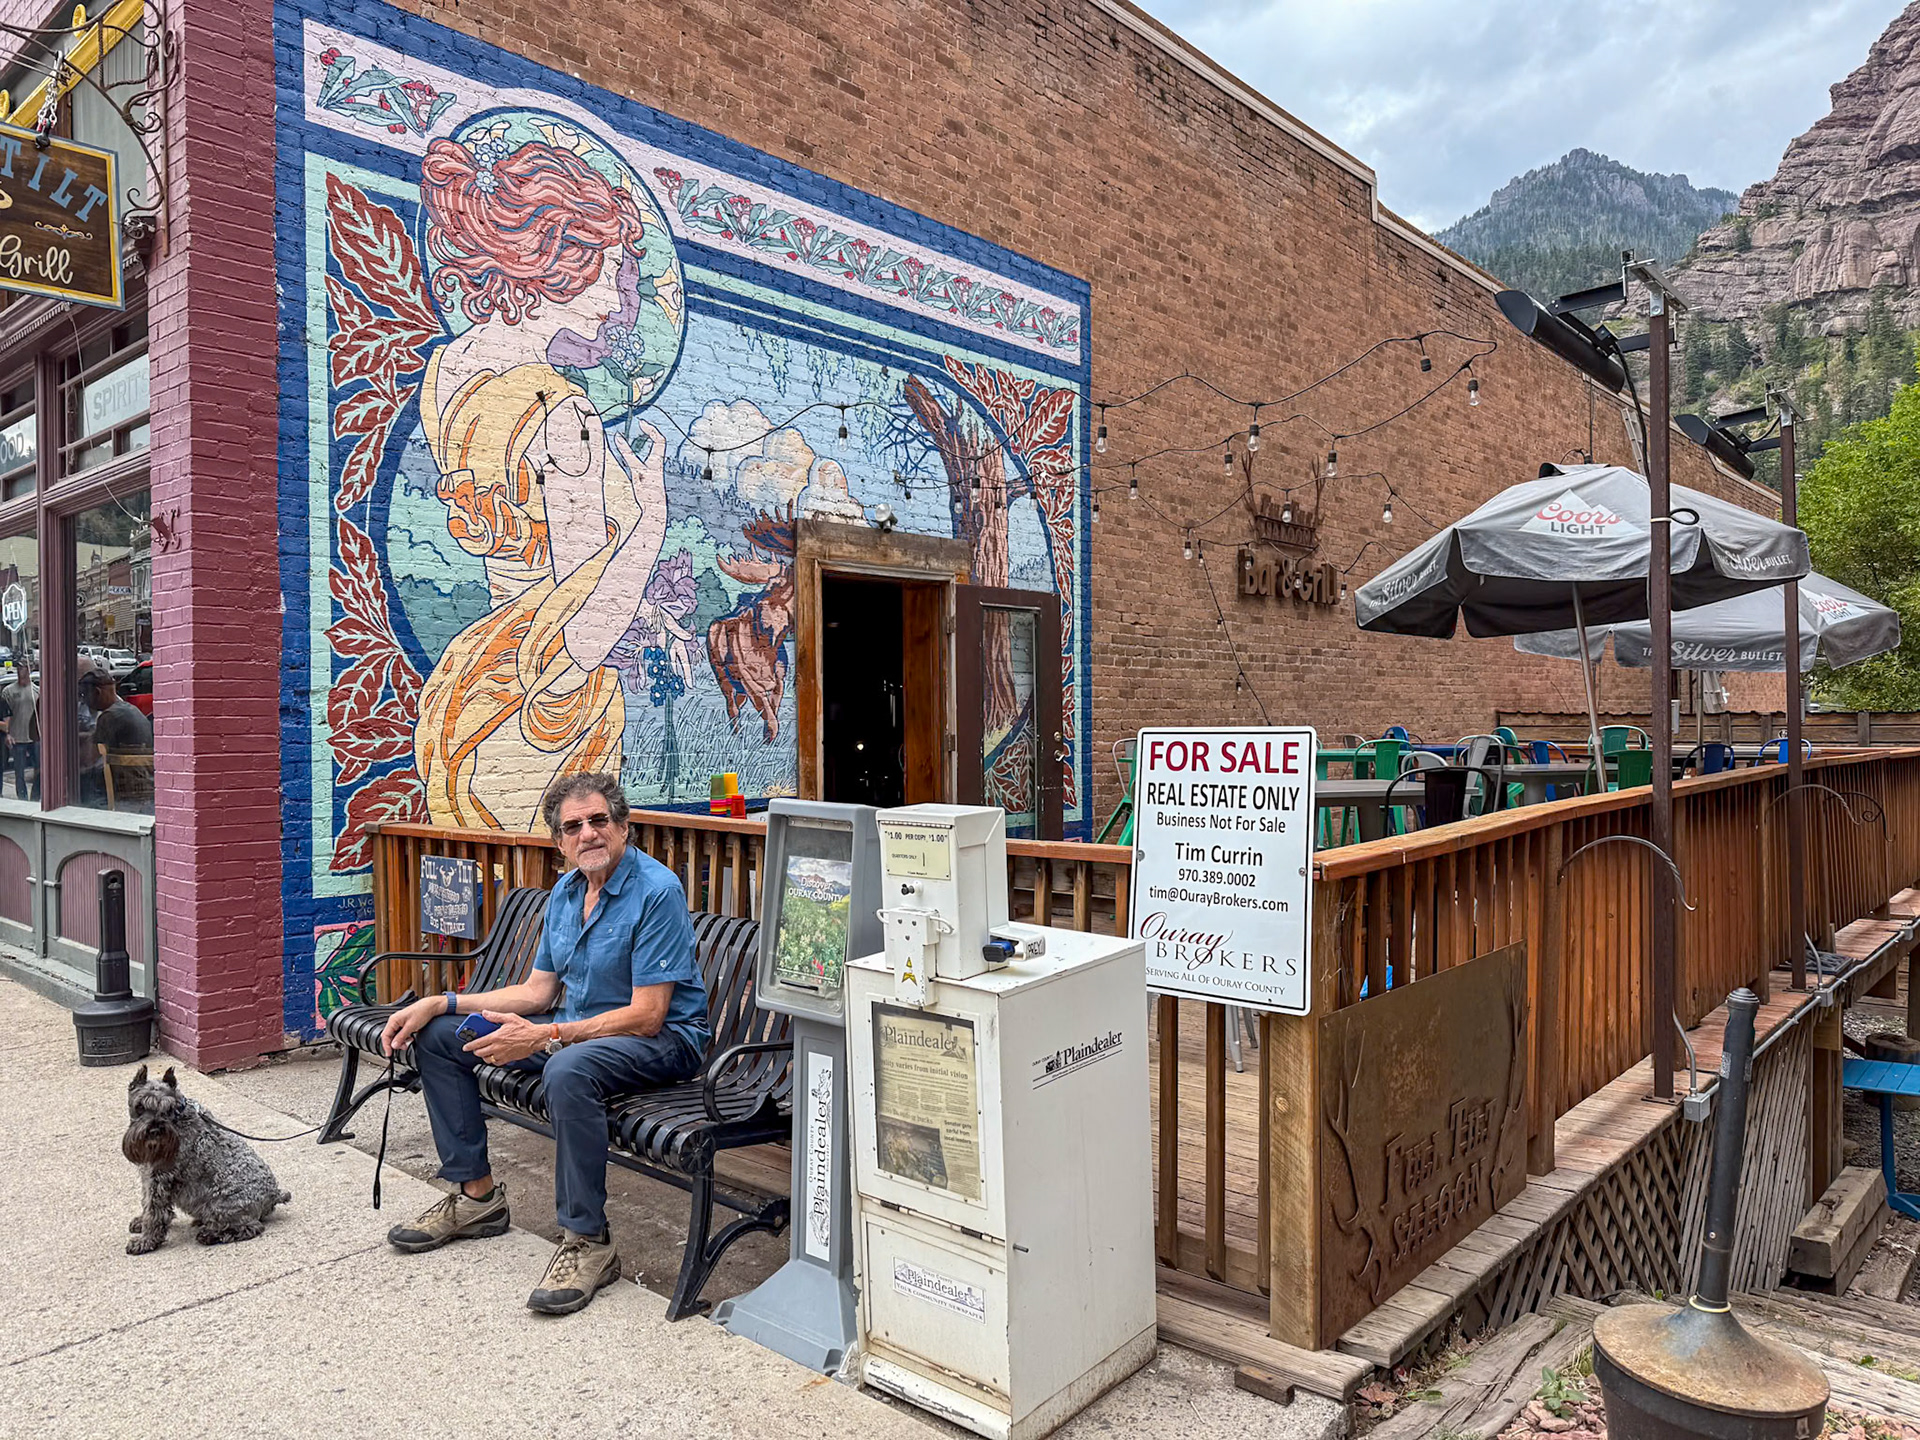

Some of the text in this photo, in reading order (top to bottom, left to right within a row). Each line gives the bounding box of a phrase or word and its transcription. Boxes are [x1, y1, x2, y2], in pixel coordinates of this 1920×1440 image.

[0, 134, 108, 223] TILT
[0, 234, 74, 285] Grill
[93, 368, 150, 420] SPIRITS
[0, 432, 24, 463] OOD
[1536, 502, 1621, 525] Coors
[1550, 522, 1605, 535] LIGHT
[1382, 573, 1417, 606] Silver
[4, 600, 25, 621] OPEN
[1670, 640, 1738, 663] Silver
[1740, 651, 1782, 661] BULLET
[1150, 741, 1299, 774] FOR SALE
[1147, 782, 1300, 812] REAL ESTATE ONLY
[1157, 811, 1286, 833] Business Not For Sale
[1175, 842, 1263, 867] Tim Currin
[421, 856, 472, 884] FULL TILT
[1178, 869, 1256, 888] 970.389.0002
[788, 887, 843, 902] OURAY COUNTY
[1149, 886, 1289, 912] tim@OurayBrokers.com
[1140, 911, 1234, 970] Ouray
[1156, 941, 1297, 976] BROKERS
[1145, 966, 1180, 980] SERVING
[1181, 972, 1196, 982] ALL
[1212, 976, 1243, 989] OURAY
[1244, 981, 1285, 995] COUNTY
[884, 1024, 958, 1051] Plaindealer
[1063, 1030, 1122, 1065] Plaindealer
[914, 1064, 929, 1073] from
[950, 1069, 968, 1079] vision
[814, 1100, 828, 1216] Plaindealer
[907, 1268, 969, 1301] Plaindealer
